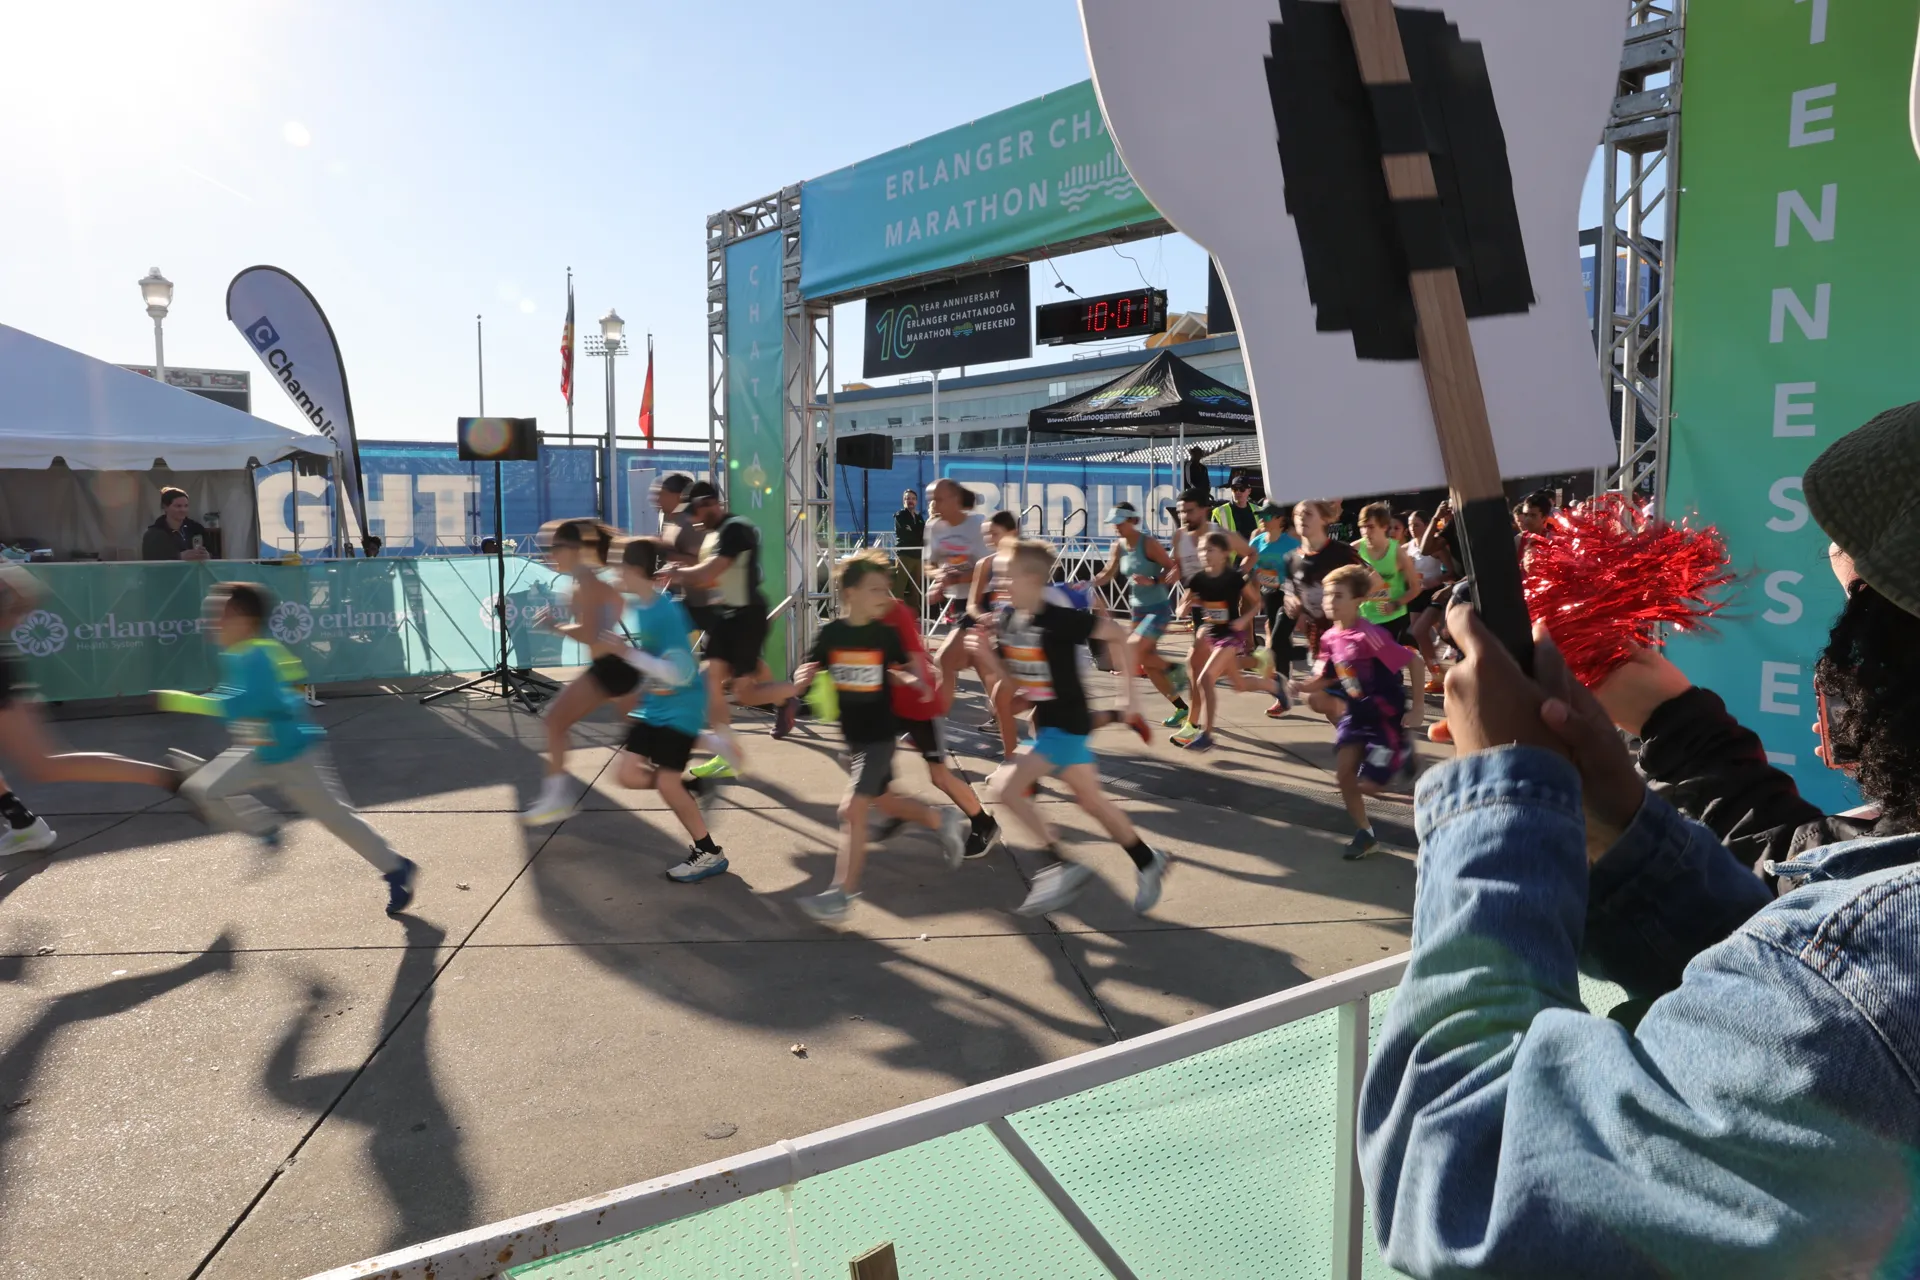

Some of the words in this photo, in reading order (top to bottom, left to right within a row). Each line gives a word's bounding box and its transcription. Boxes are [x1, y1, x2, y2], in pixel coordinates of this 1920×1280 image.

[886, 129, 1034, 200] ERLANGER
[885, 179, 1048, 249] MARATHON
[906, 312, 948, 329] ERLANGER
[950, 302, 1016, 322] CHATTANOOGA
[920, 299, 940, 312] YEAR
[943, 289, 1000, 309] ANNIVERSARY
[875, 304, 918, 361] 10
[906, 328, 951, 343] MARATHON
[975, 317, 1016, 332] WEEKEND
[73, 612, 208, 646] erlanger
[111, 639, 144, 650] System
